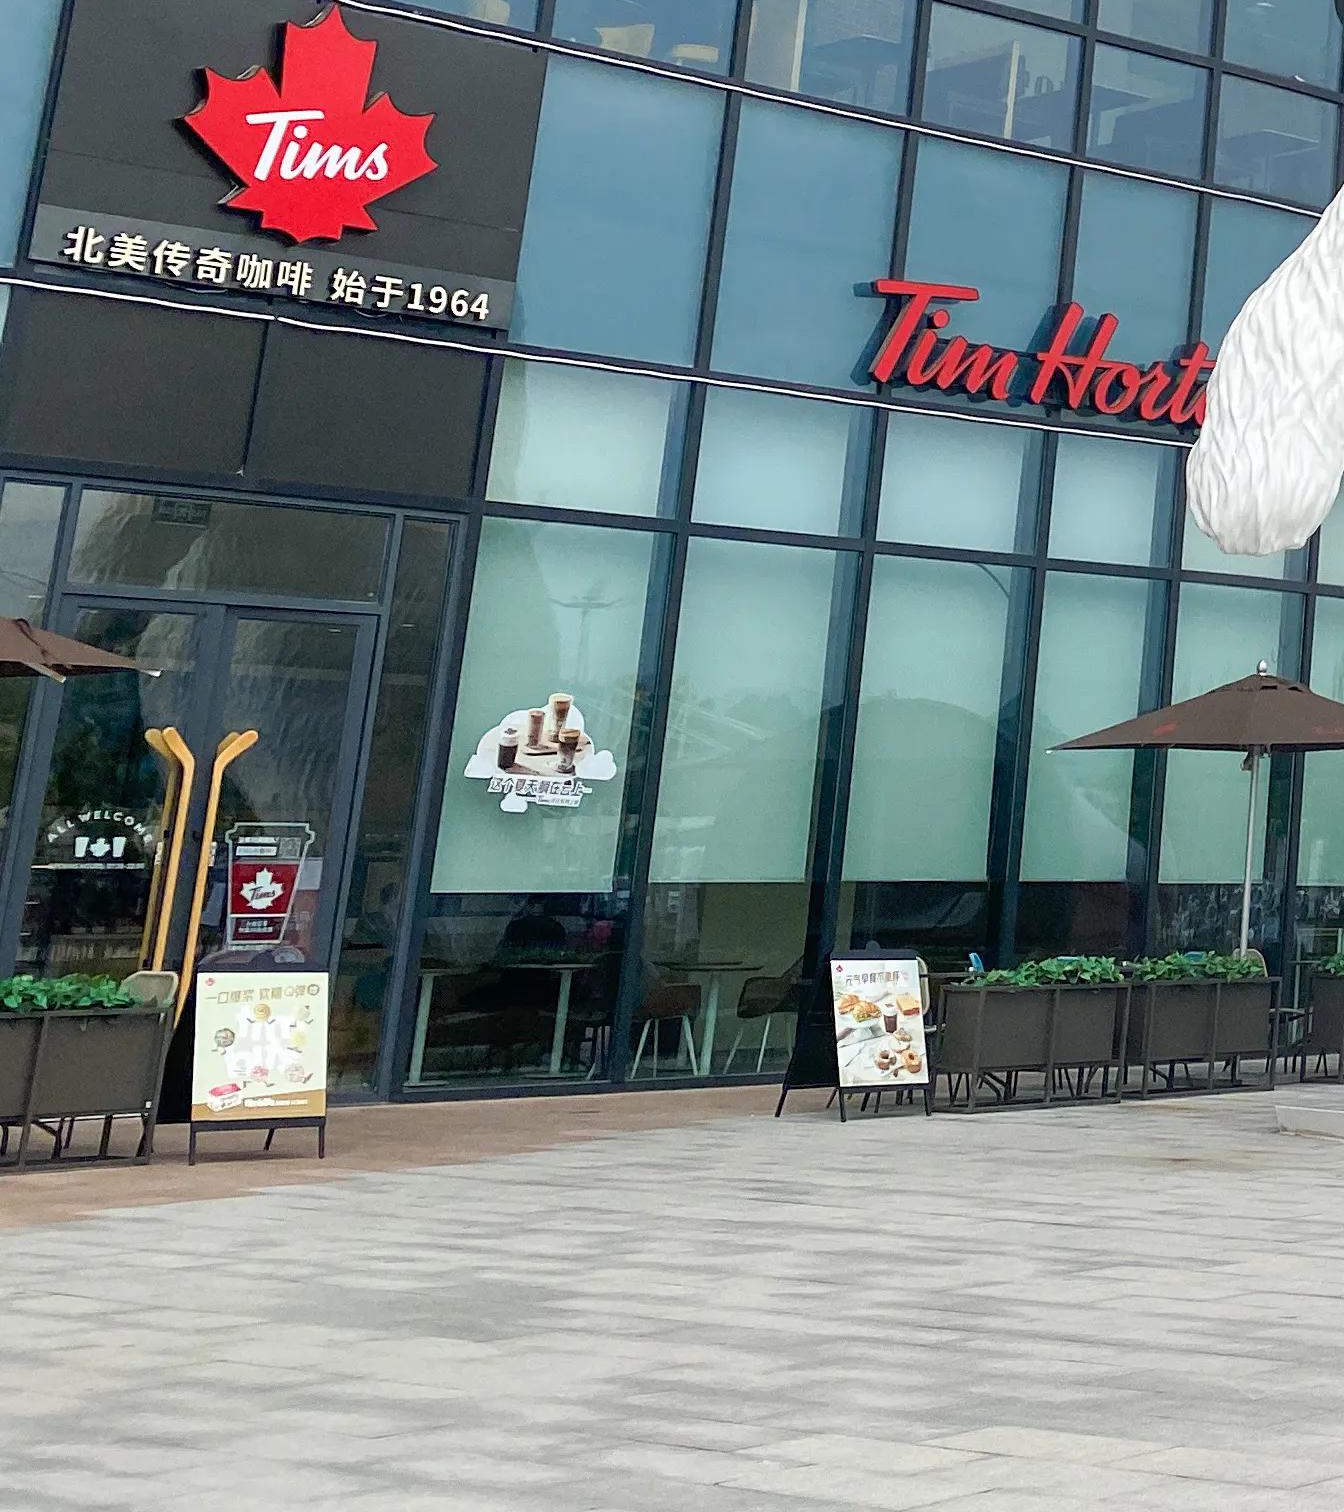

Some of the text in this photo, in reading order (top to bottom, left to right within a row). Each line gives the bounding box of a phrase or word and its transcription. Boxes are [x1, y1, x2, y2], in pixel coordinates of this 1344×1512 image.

[245, 109, 389, 182] Tims
[64, 225, 489, 320] 北美传奇咖啡 始于1964
[872, 278, 1218, 428] Tim Hort
